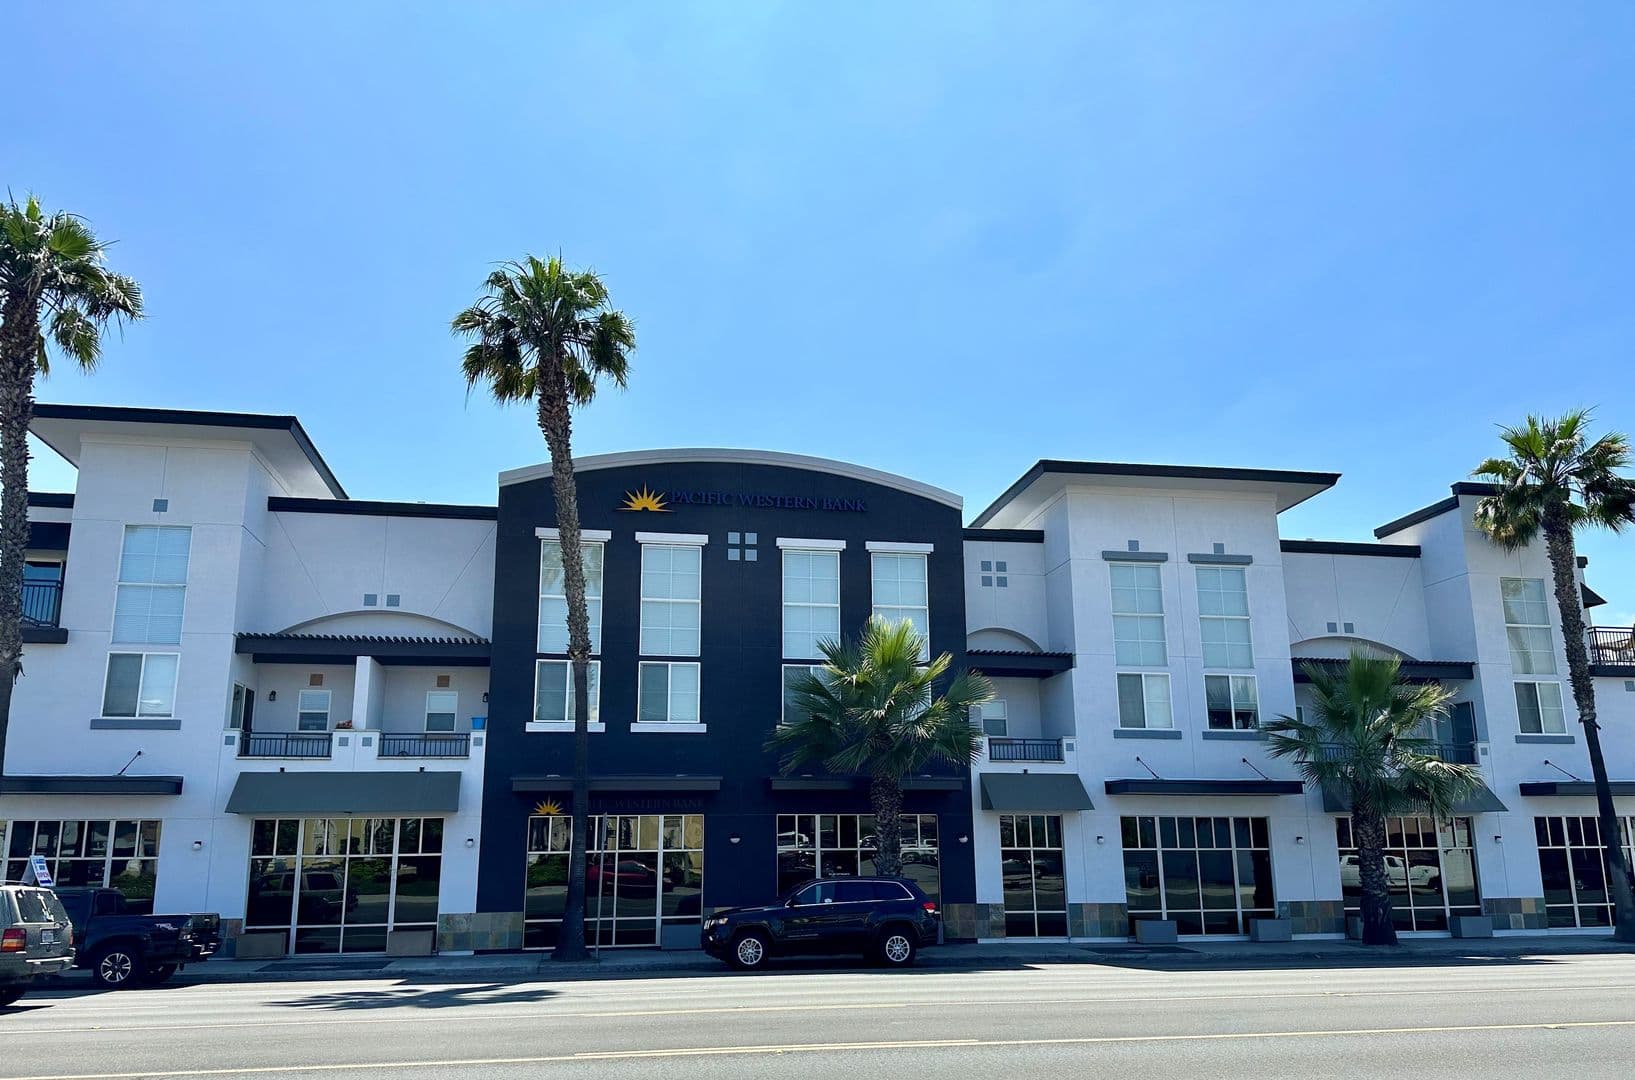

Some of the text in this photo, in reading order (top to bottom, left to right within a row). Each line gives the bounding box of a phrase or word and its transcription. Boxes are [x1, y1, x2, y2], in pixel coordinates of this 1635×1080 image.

[671, 490, 865, 511] PACIFIC WESTERN BANK
[673, 799, 704, 809] BANK
